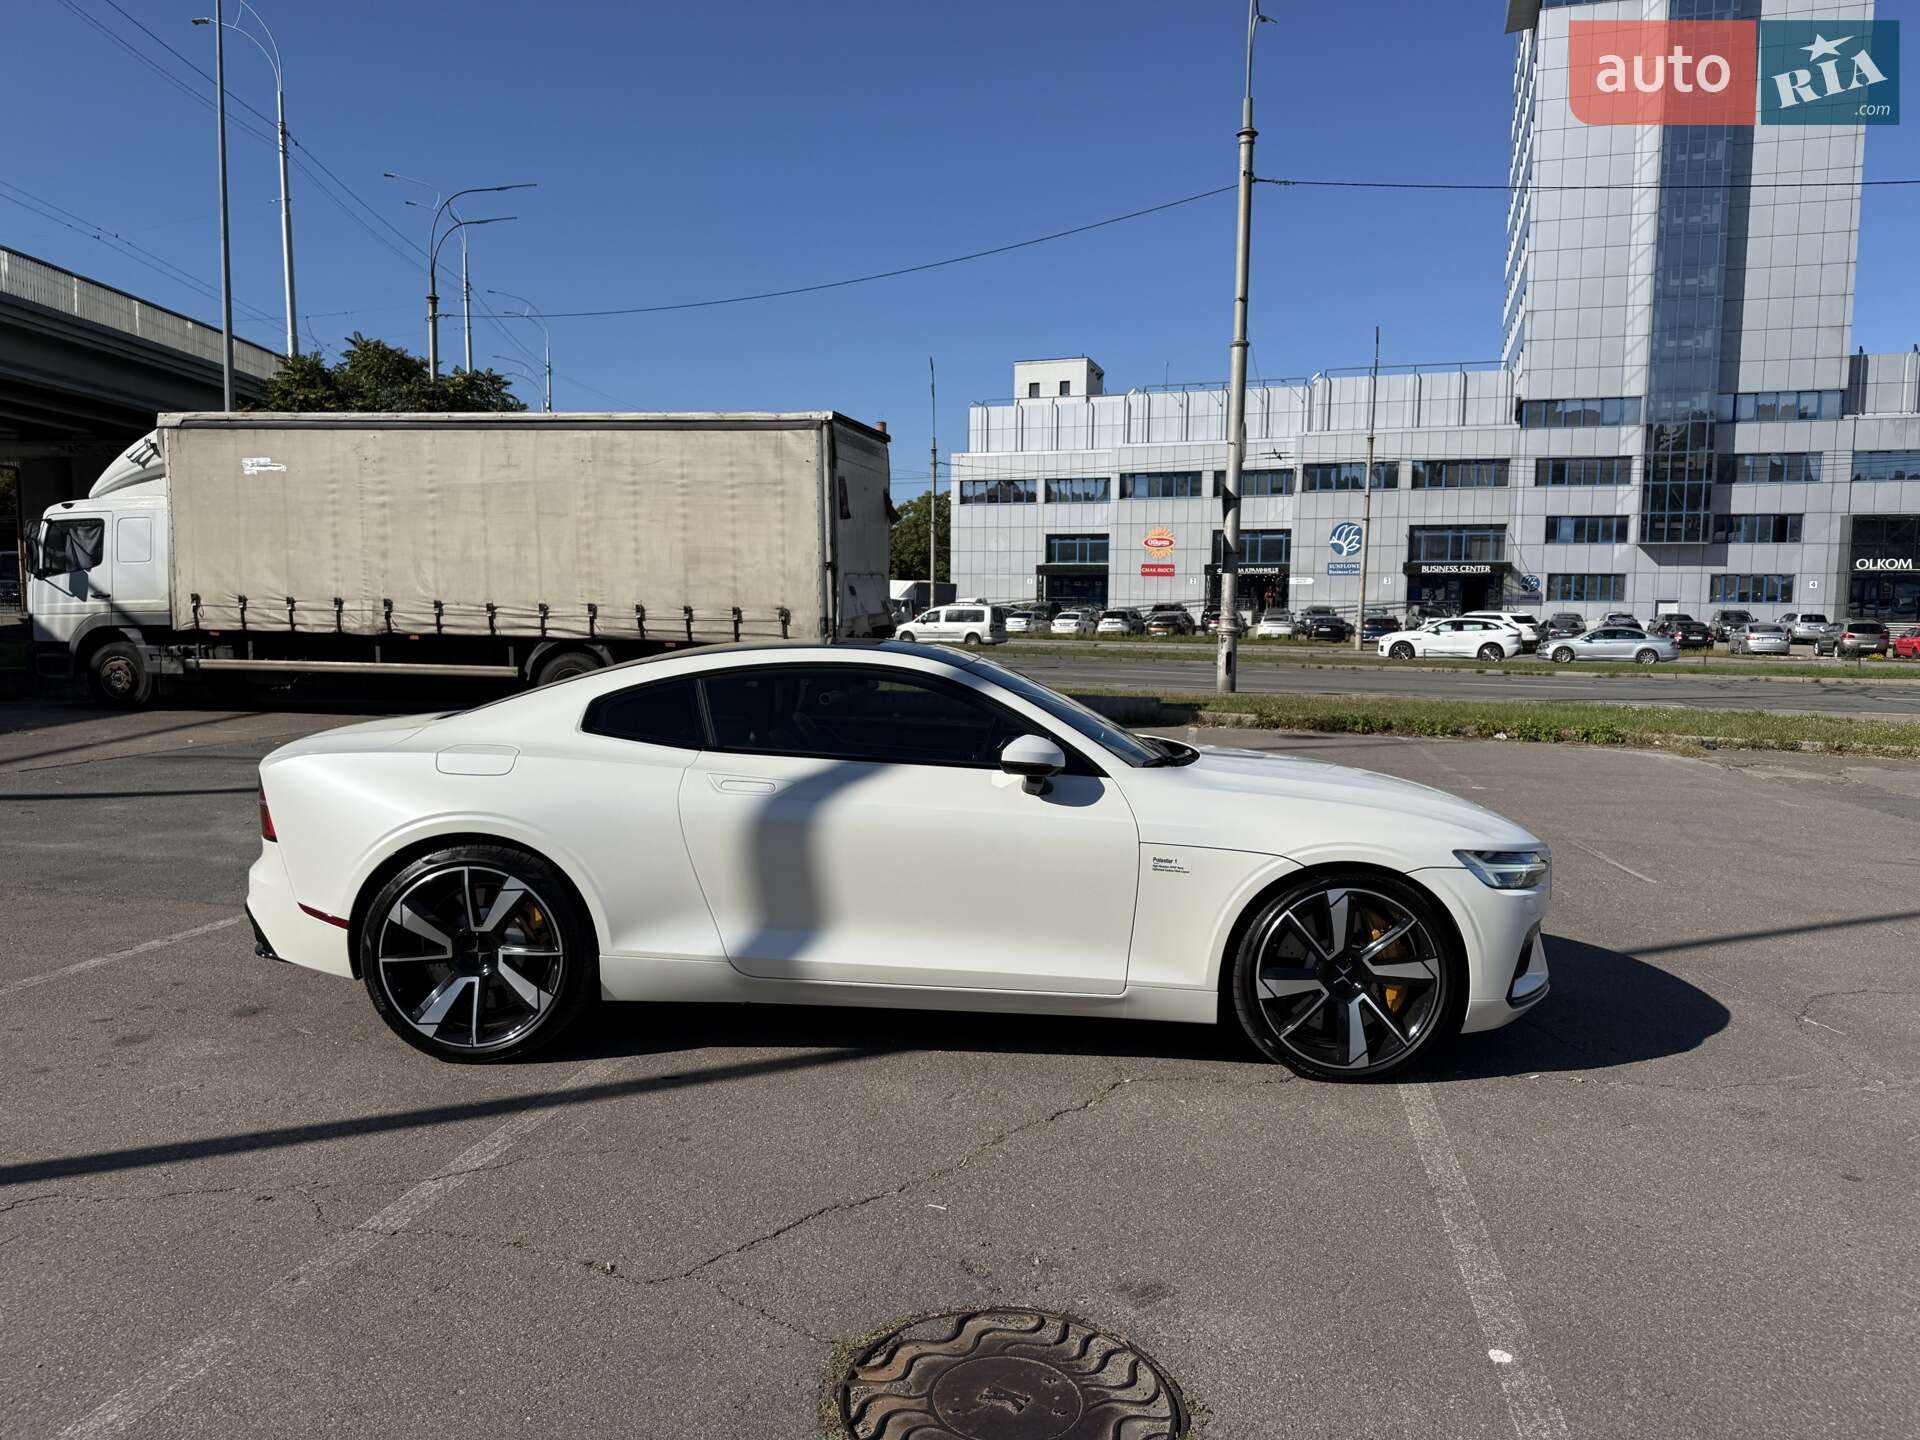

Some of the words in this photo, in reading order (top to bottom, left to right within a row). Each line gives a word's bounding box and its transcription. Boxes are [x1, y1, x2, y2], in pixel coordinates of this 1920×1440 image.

[1855, 558, 1913, 570] OLKOM
[1421, 565, 1459, 574] BUSINESS
[1460, 565, 1491, 573] CENTER
